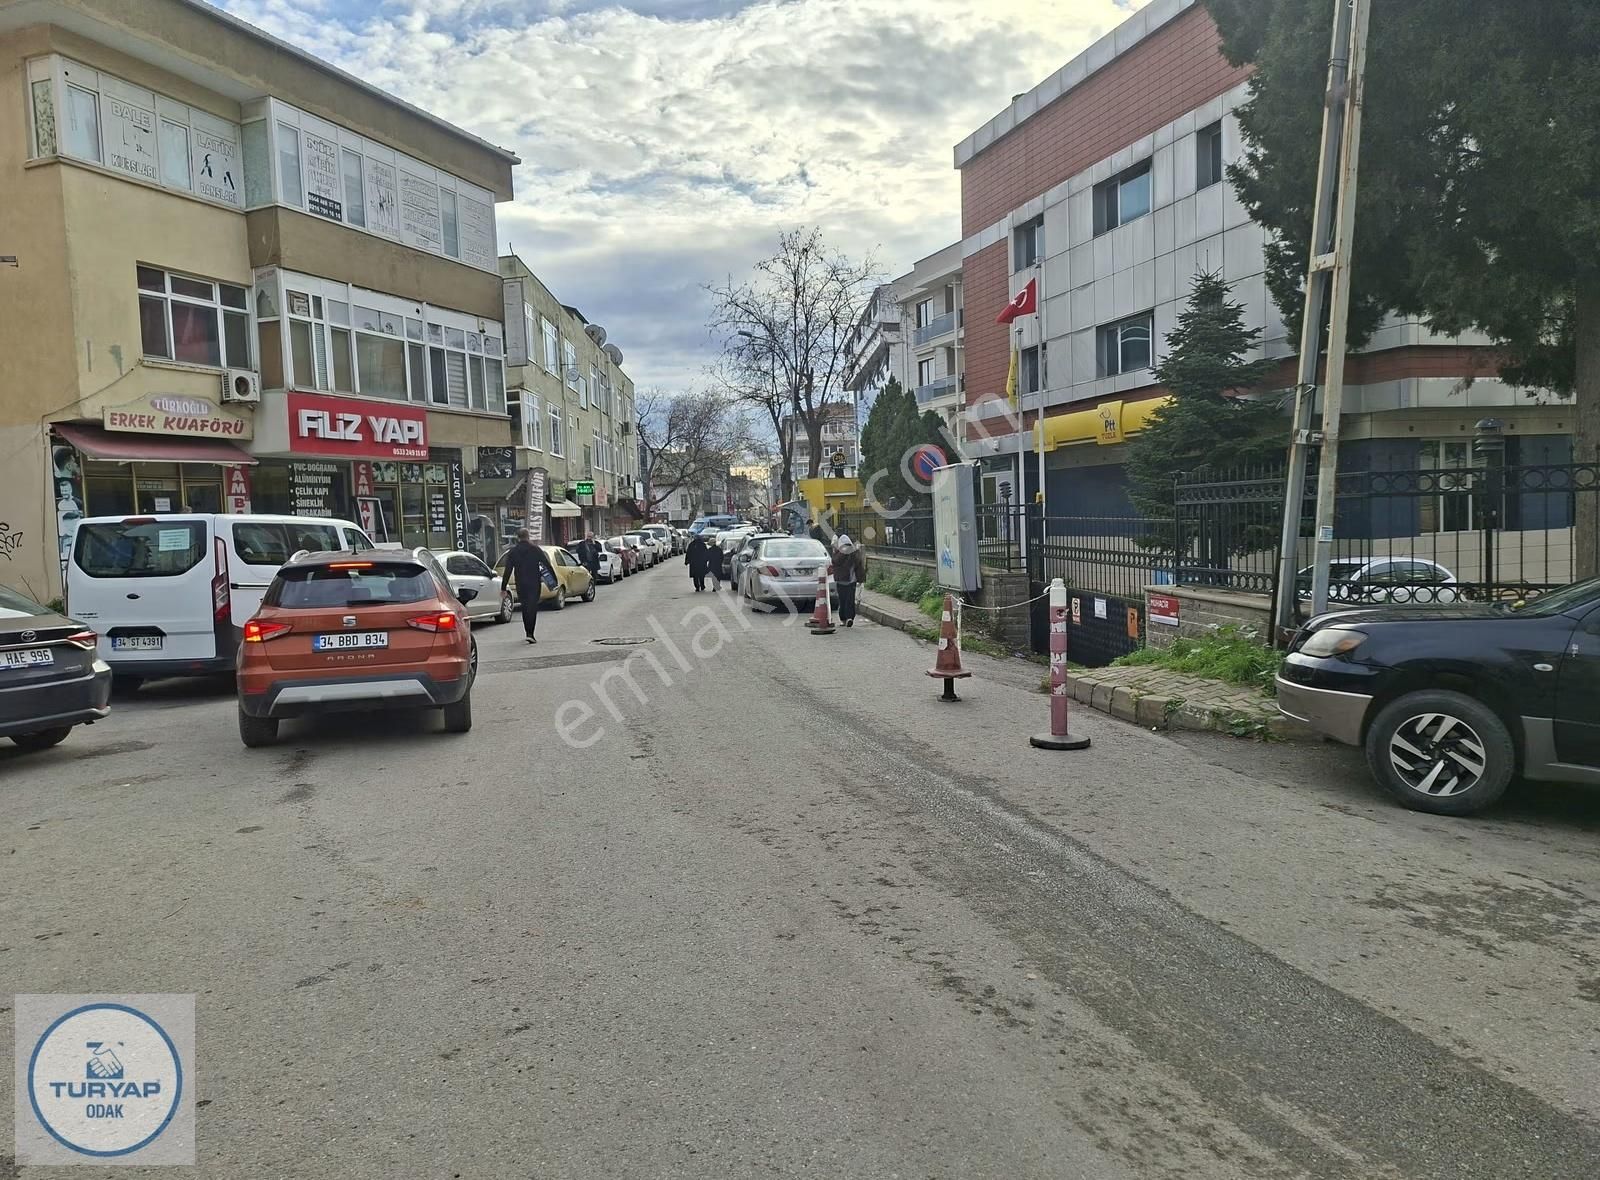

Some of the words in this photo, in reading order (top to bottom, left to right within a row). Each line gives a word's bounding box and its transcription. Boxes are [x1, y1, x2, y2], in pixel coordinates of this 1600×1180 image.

[111, 102, 151, 127] BALE
[110, 412, 156, 430] ERKEK
[163, 416, 244, 435] KUAFÖRÜ
[367, 415, 424, 445] YAPI
[295, 485, 313, 498] ÇELİK
[314, 487, 329, 496] KAPI
[452, 463, 461, 498] KLAS
[454, 503, 465, 551] KUAFÖ
[117, 638, 127, 647] 34
[131, 638, 140, 647] ST
[142, 637, 160, 647] 4391
[320, 636, 334, 648] 34
[338, 635, 359, 647] BBD
[365, 634, 385, 645] 834
[5, 652, 27, 665] HAE
[30, 650, 50, 662] 996
